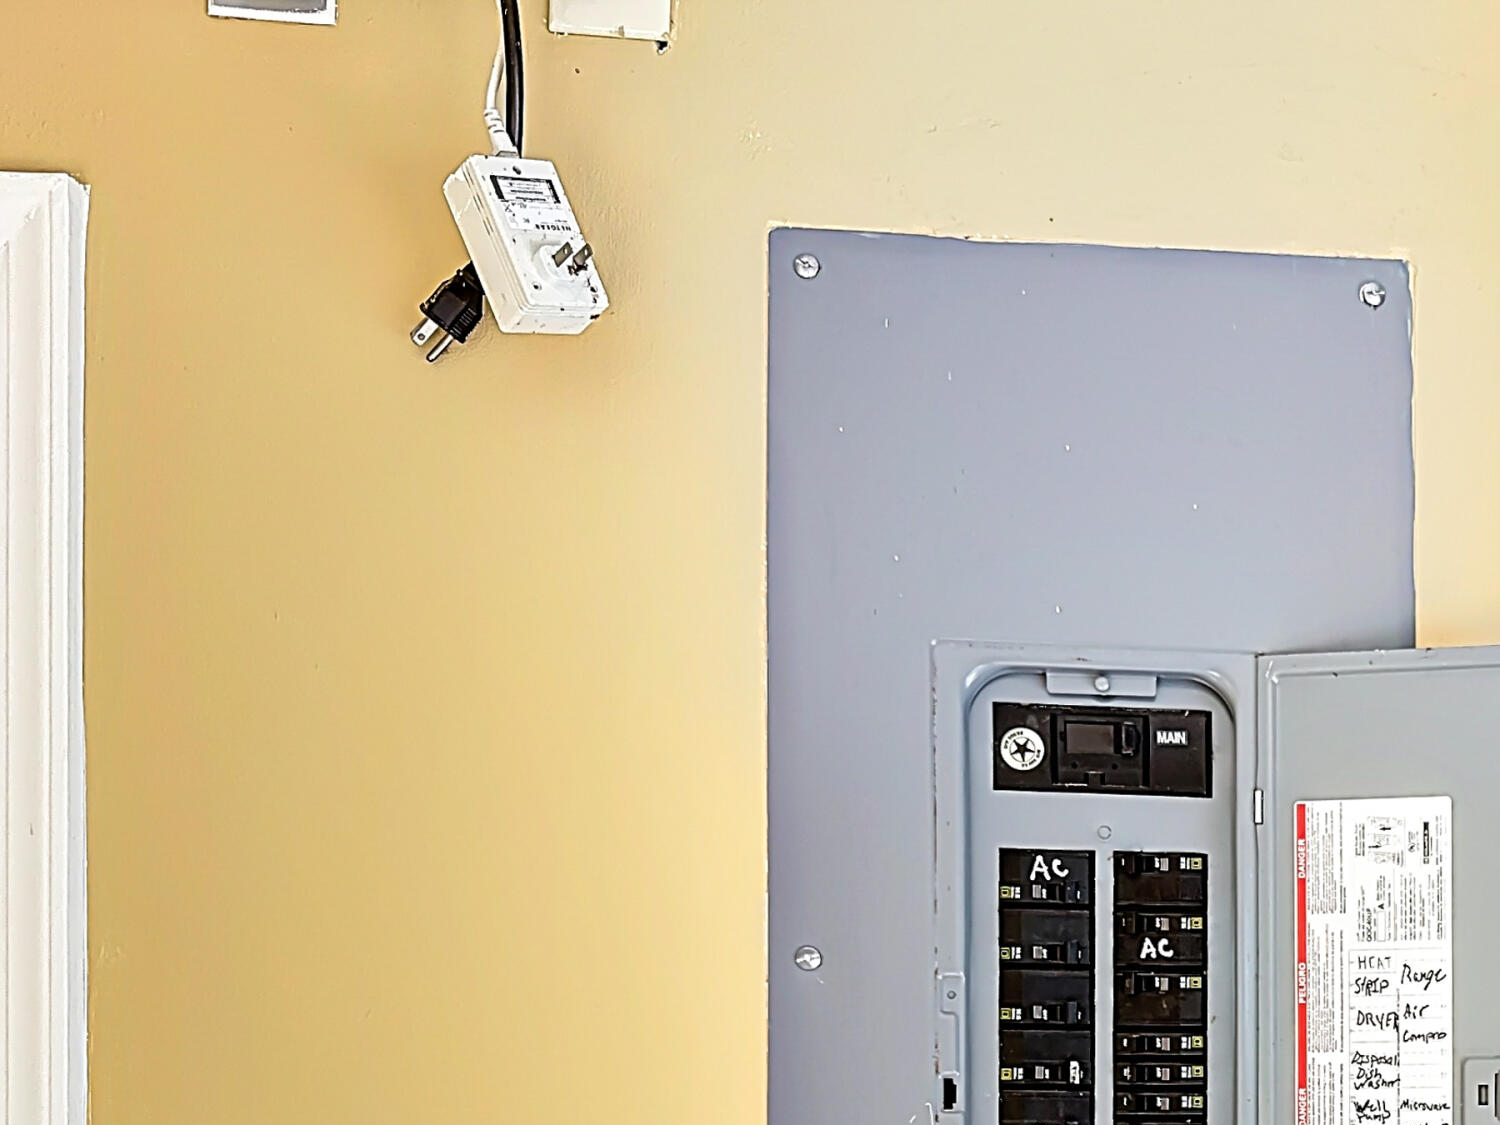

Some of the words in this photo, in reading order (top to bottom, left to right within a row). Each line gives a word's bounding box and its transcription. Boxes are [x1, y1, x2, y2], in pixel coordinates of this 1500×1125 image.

[1156, 730, 1186, 745] MAIN
[1298, 839, 1306, 879] DANGER
[1358, 955, 1392, 970] HEAT
[1298, 963, 1306, 1004] PELIGRO
[1400, 963, 1447, 991] Range
[1403, 1003, 1429, 1019] Air
